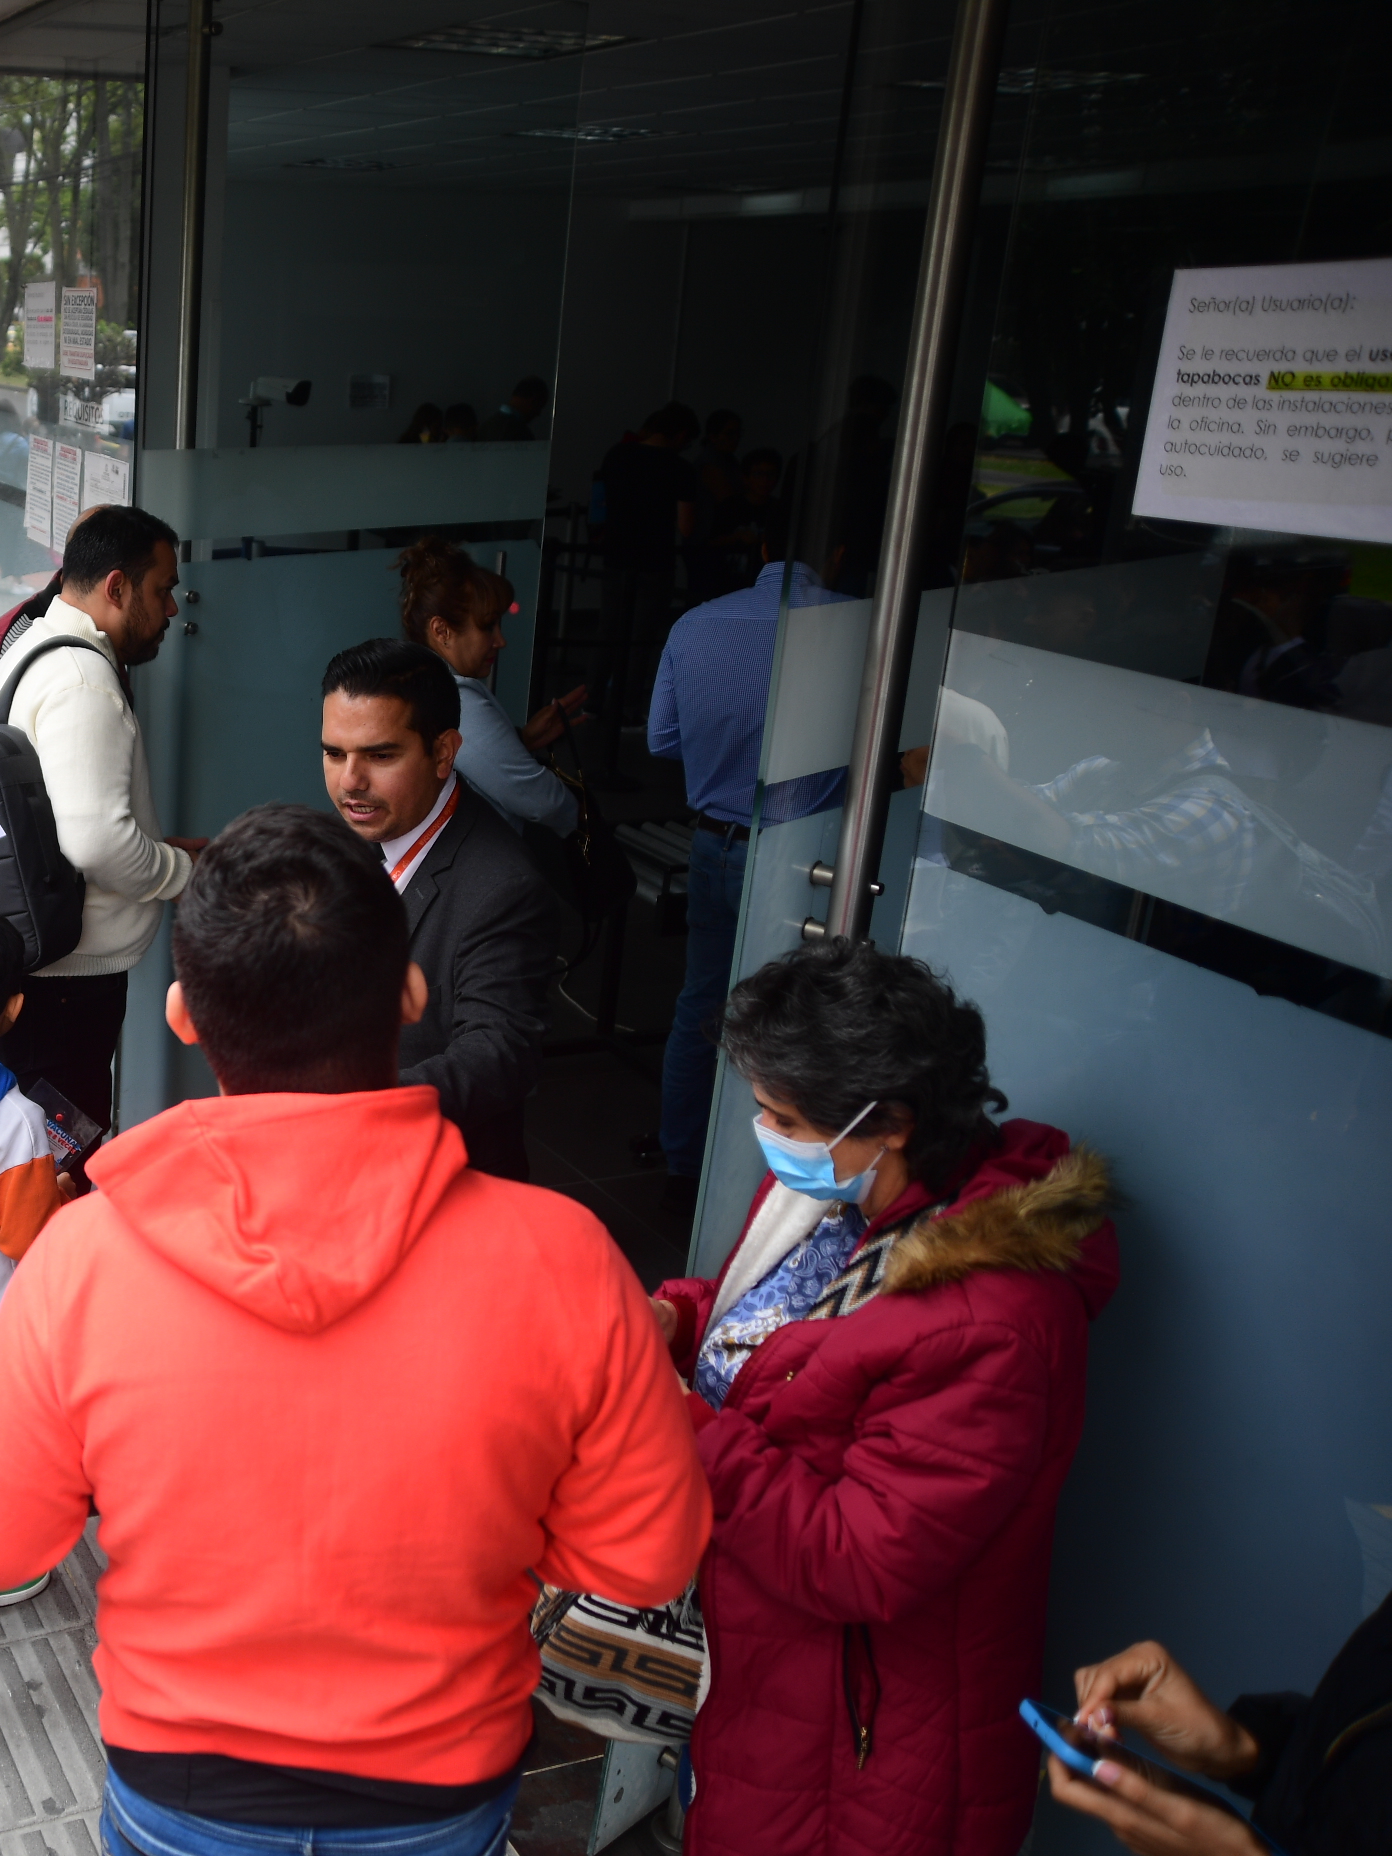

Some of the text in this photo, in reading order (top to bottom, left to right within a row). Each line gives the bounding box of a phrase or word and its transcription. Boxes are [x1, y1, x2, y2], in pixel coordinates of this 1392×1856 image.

[1188, 293, 1357, 316] Señor(a) Usuario(a):
[1177, 345, 1196, 361] Se
[1201, 345, 1215, 361] le
[1219, 345, 1296, 362] recuerda
[1303, 348, 1338, 365] que
[1345, 345, 1363, 362] el
[1176, 368, 1261, 387] tapabocas
[1267, 370, 1296, 386] NO
[1303, 374, 1322, 387] es
[1171, 393, 1392, 415] dentro de las instalaciones
[1167, 415, 1181, 431] la
[1189, 416, 1244, 435] oficina.
[1254, 418, 1276, 436] Sin
[1286, 421, 1375, 444] embargo,
[1163, 438, 1379, 469] autocuidado, se sugiere
[1159, 462, 1187, 478] uso.
